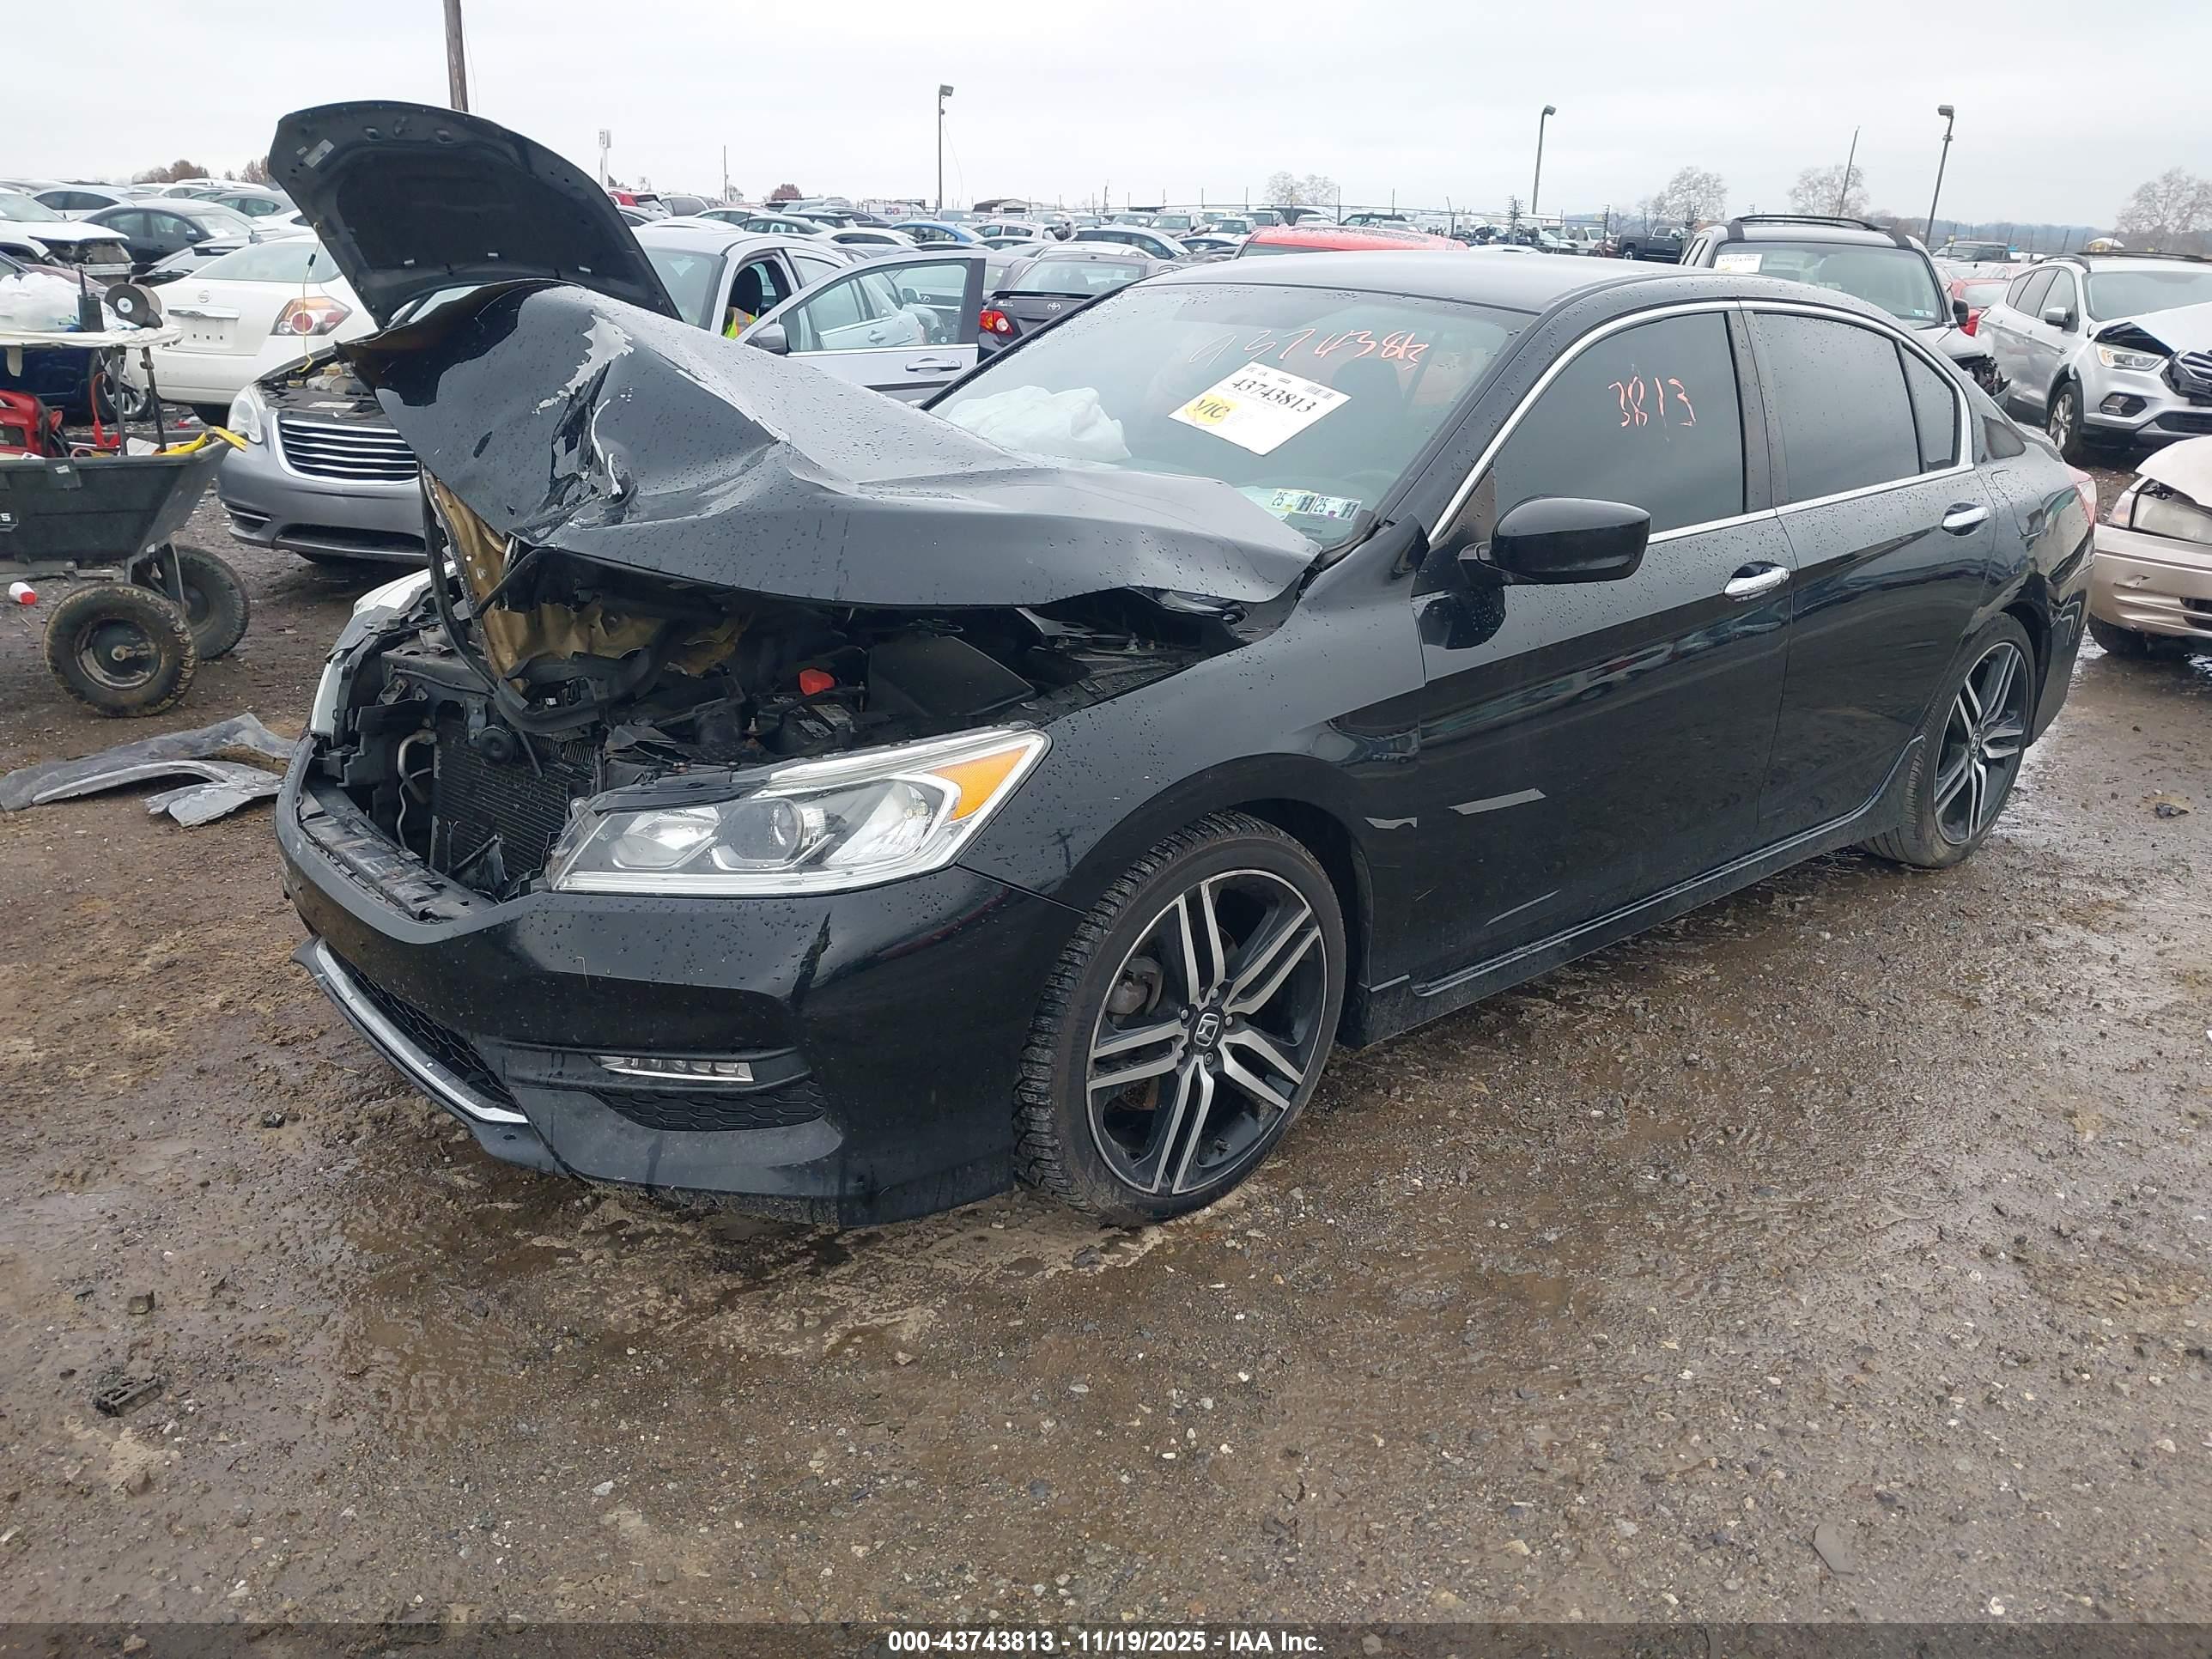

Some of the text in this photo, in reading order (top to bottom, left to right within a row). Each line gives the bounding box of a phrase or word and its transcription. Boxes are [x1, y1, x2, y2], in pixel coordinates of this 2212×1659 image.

[1193, 398, 1231, 419] VIC
[1232, 378, 1317, 413] 43743813
[1607, 375, 1697, 428] 3813
